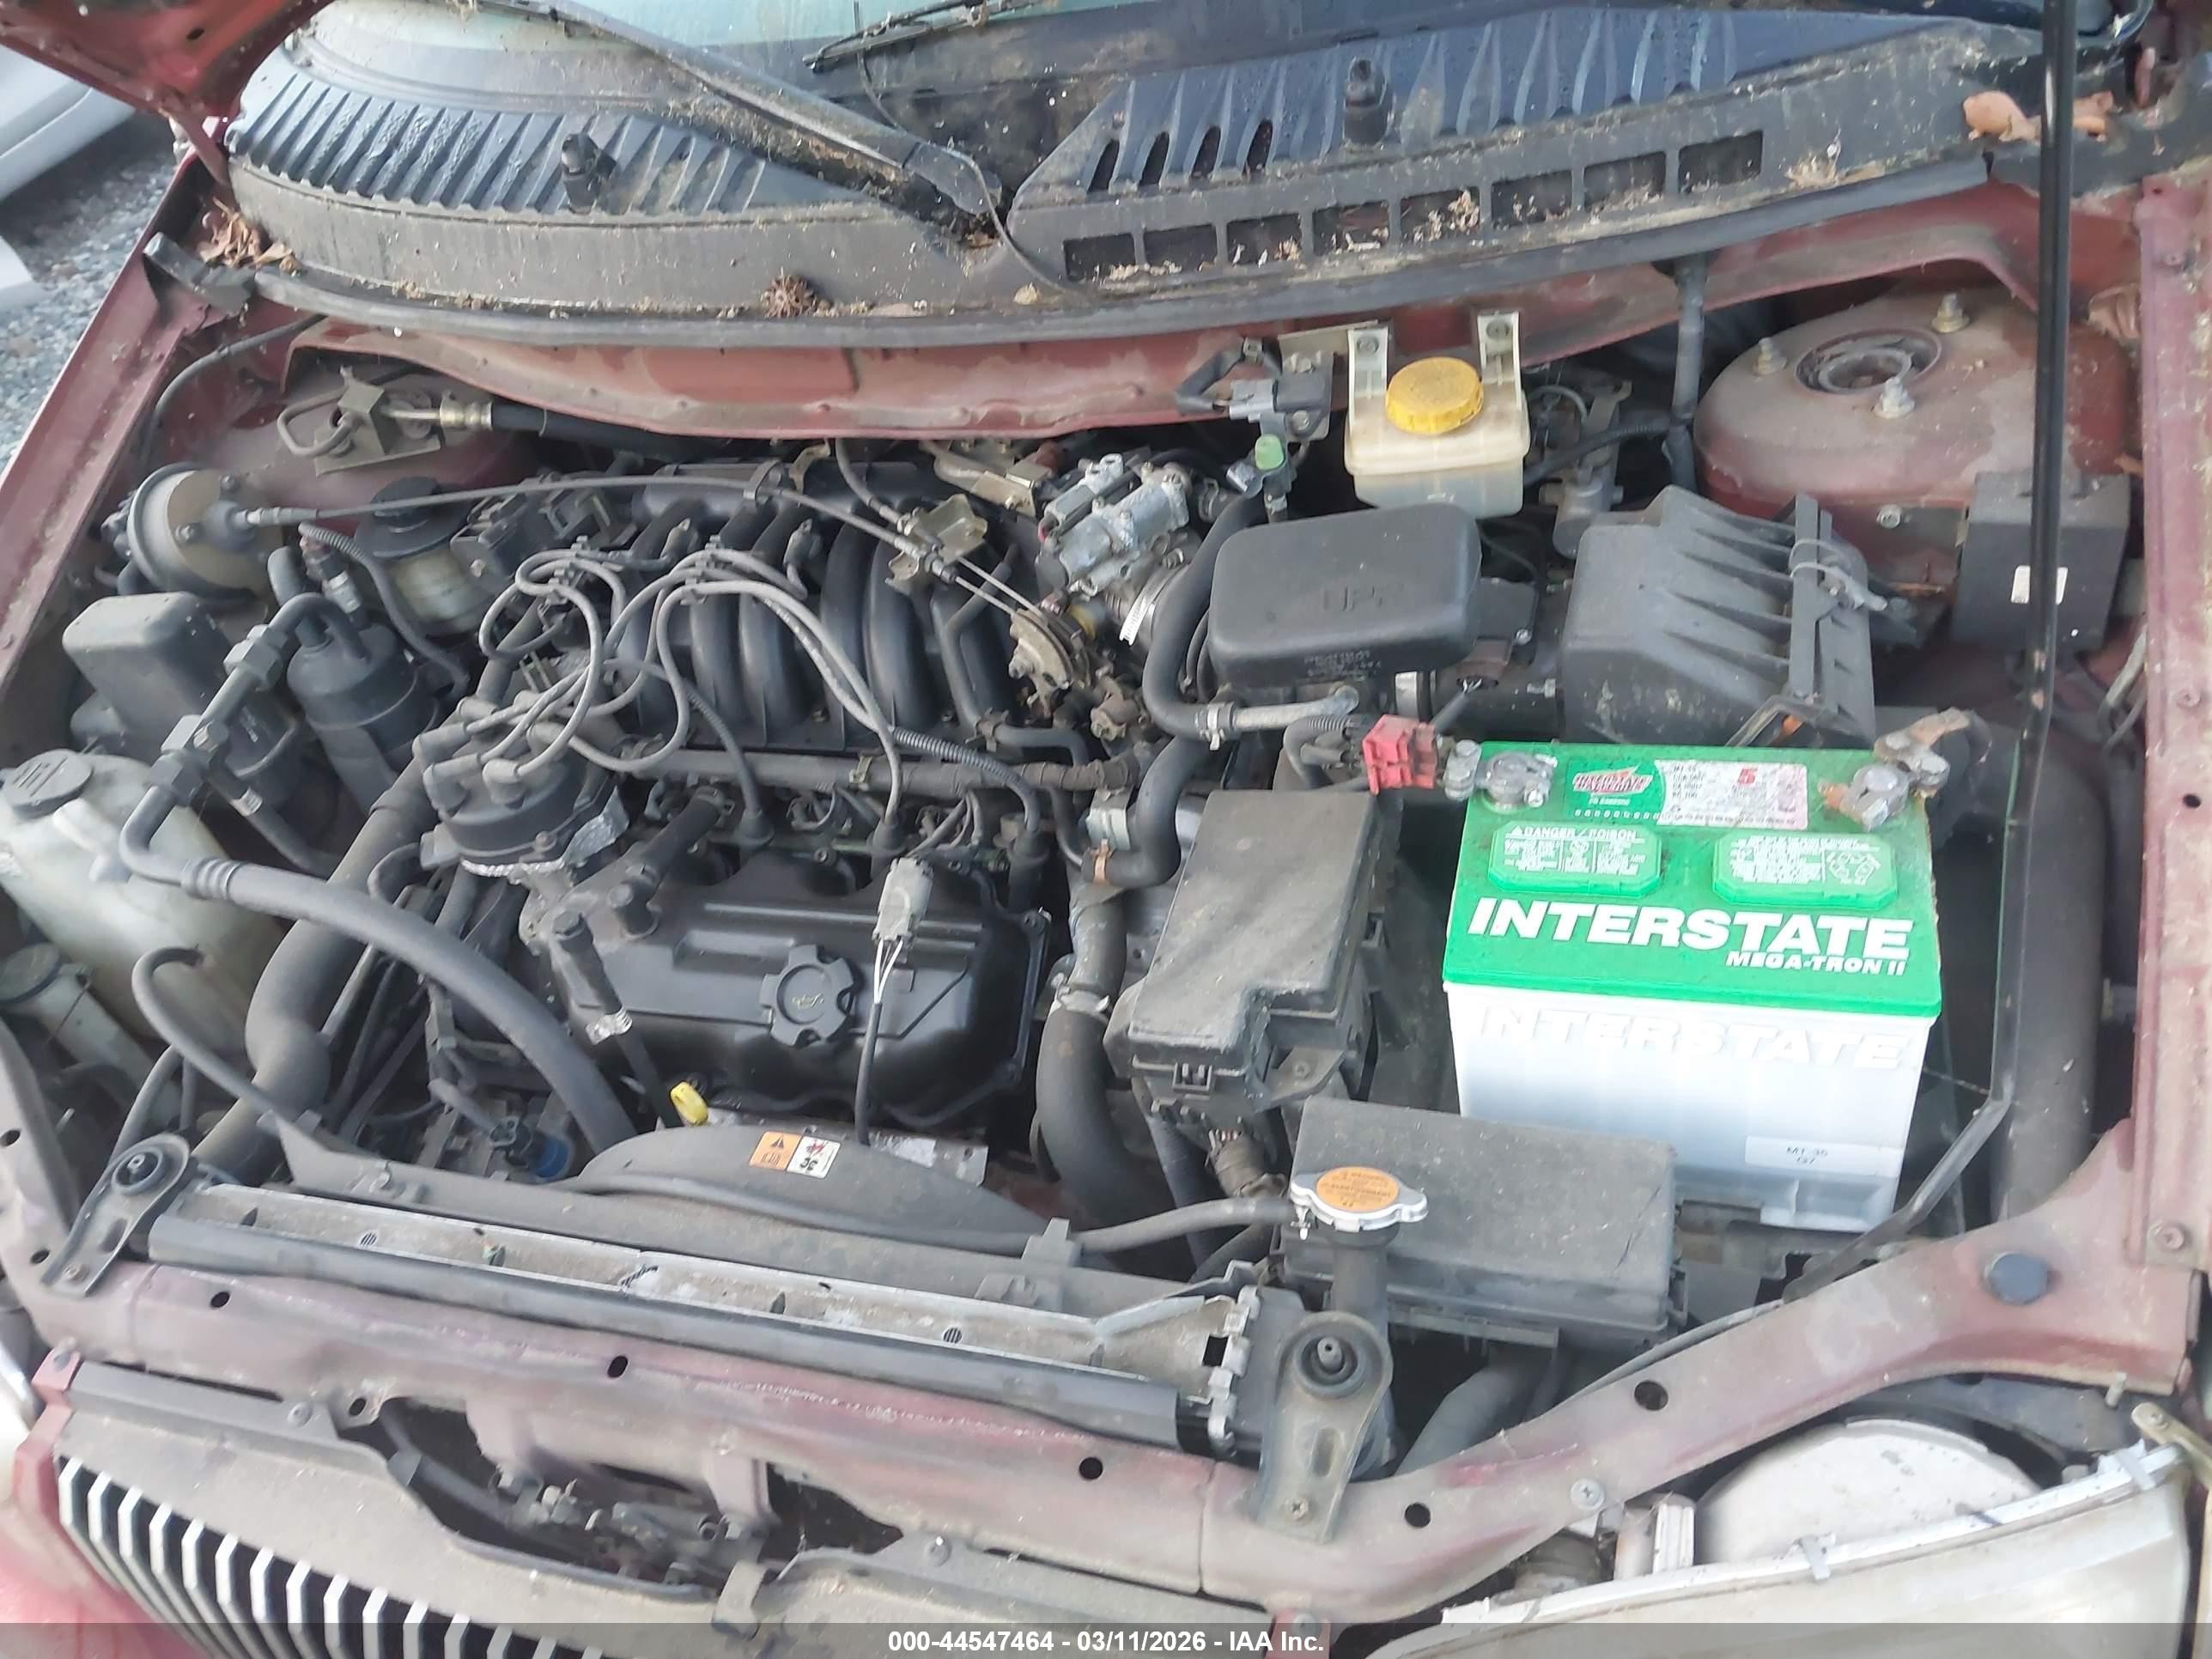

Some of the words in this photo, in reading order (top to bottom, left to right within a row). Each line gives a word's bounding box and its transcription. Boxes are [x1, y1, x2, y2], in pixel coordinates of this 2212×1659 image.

[1524, 826, 1576, 839] DANGER
[1468, 897, 1914, 960] INTERSTATE
[1726, 951, 1881, 975] MEGA-TRON
[1888, 960, 1905, 976] II
[1473, 1002, 1911, 1071] INTERSTATE
